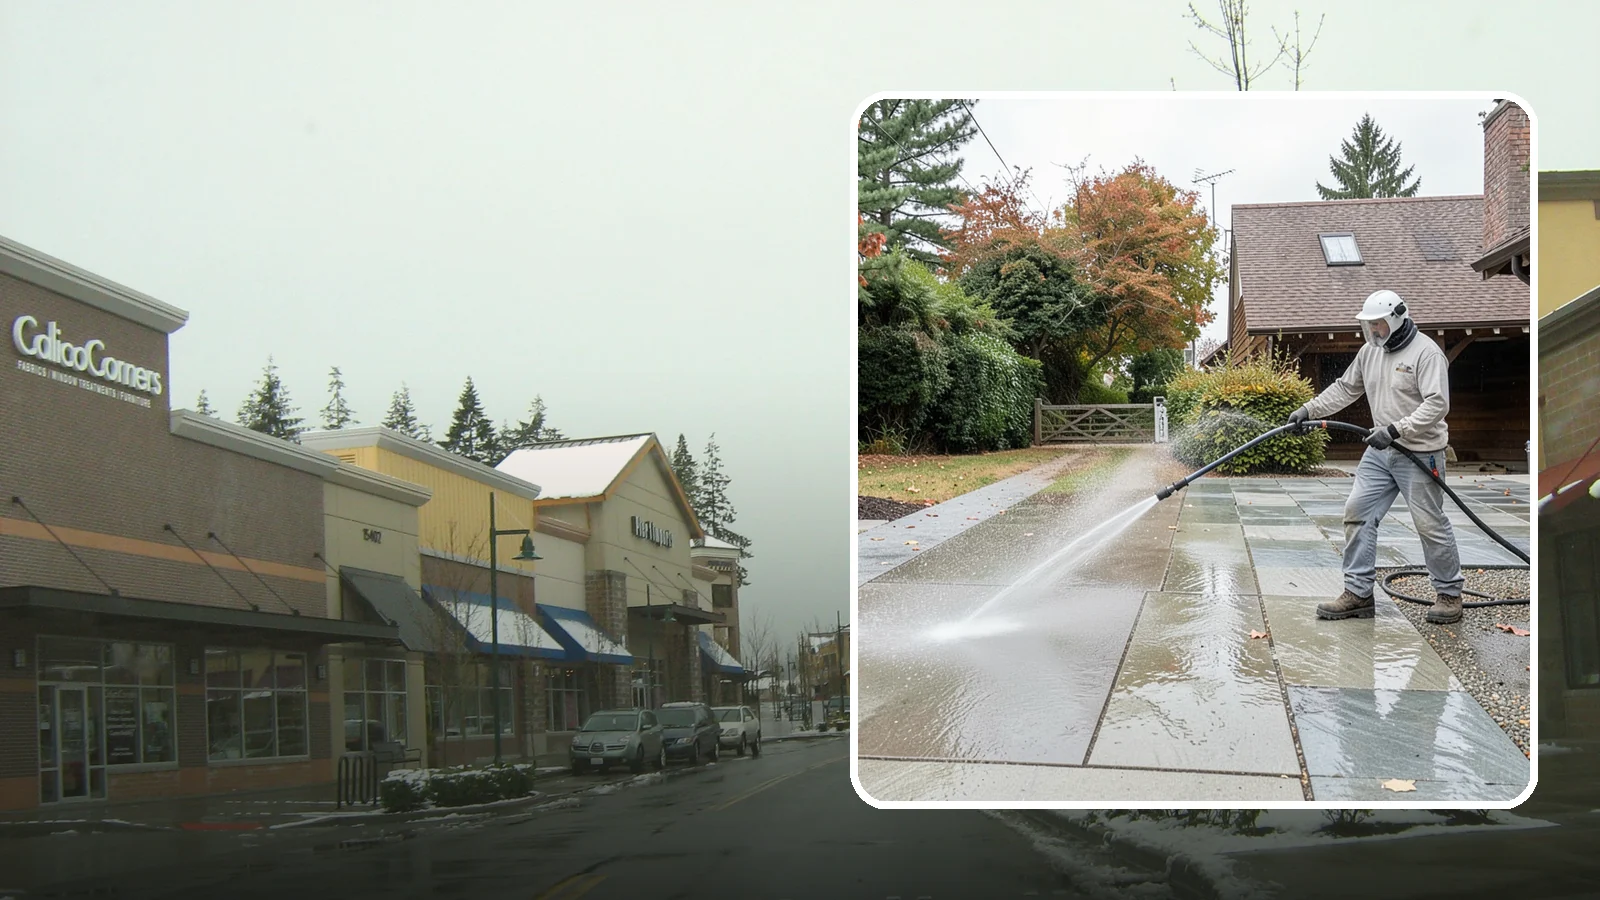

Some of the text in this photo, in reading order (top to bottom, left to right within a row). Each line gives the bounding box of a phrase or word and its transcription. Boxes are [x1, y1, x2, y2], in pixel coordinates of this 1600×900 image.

[17, 360, 151, 408] FABRICS WINDOW TREATMENTS FURNITURE
